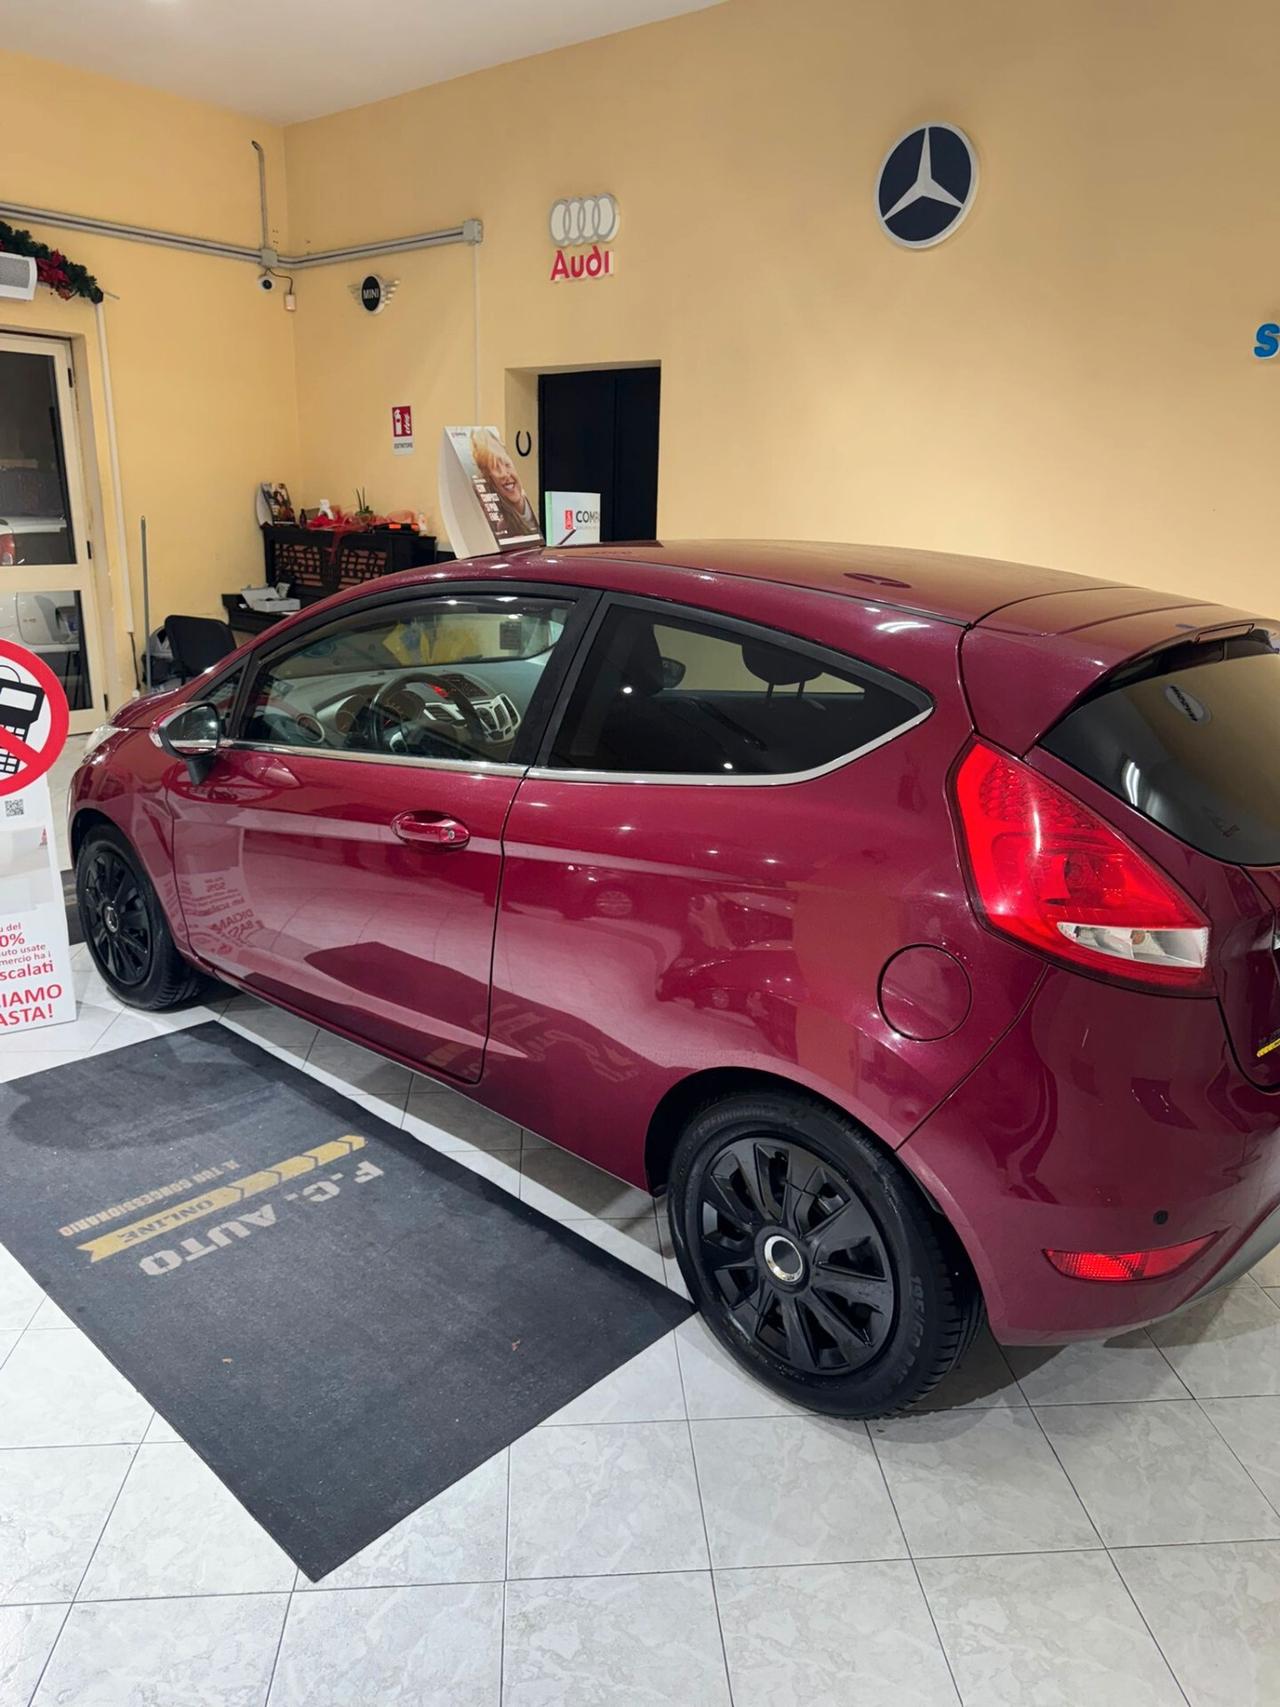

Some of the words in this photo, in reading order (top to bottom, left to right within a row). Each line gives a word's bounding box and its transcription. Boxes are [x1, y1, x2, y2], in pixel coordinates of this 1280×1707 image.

[550, 244, 610, 281] Audi
[362, 287, 380, 299] MINI
[1253, 322, 1280, 358] S
[6, 922, 21, 932] del
[20, 943, 46, 954] usate
[34, 951, 46, 961] ha
[0, 960, 54, 981] scalati
[0, 984, 62, 1008] IAMO
[192, 1166, 225, 1184] TUO
[57, 1175, 193, 1238] CONCESSIONARIO
[115, 1198, 217, 1244] ONLINE
[138, 1203, 278, 1276] AUTO
